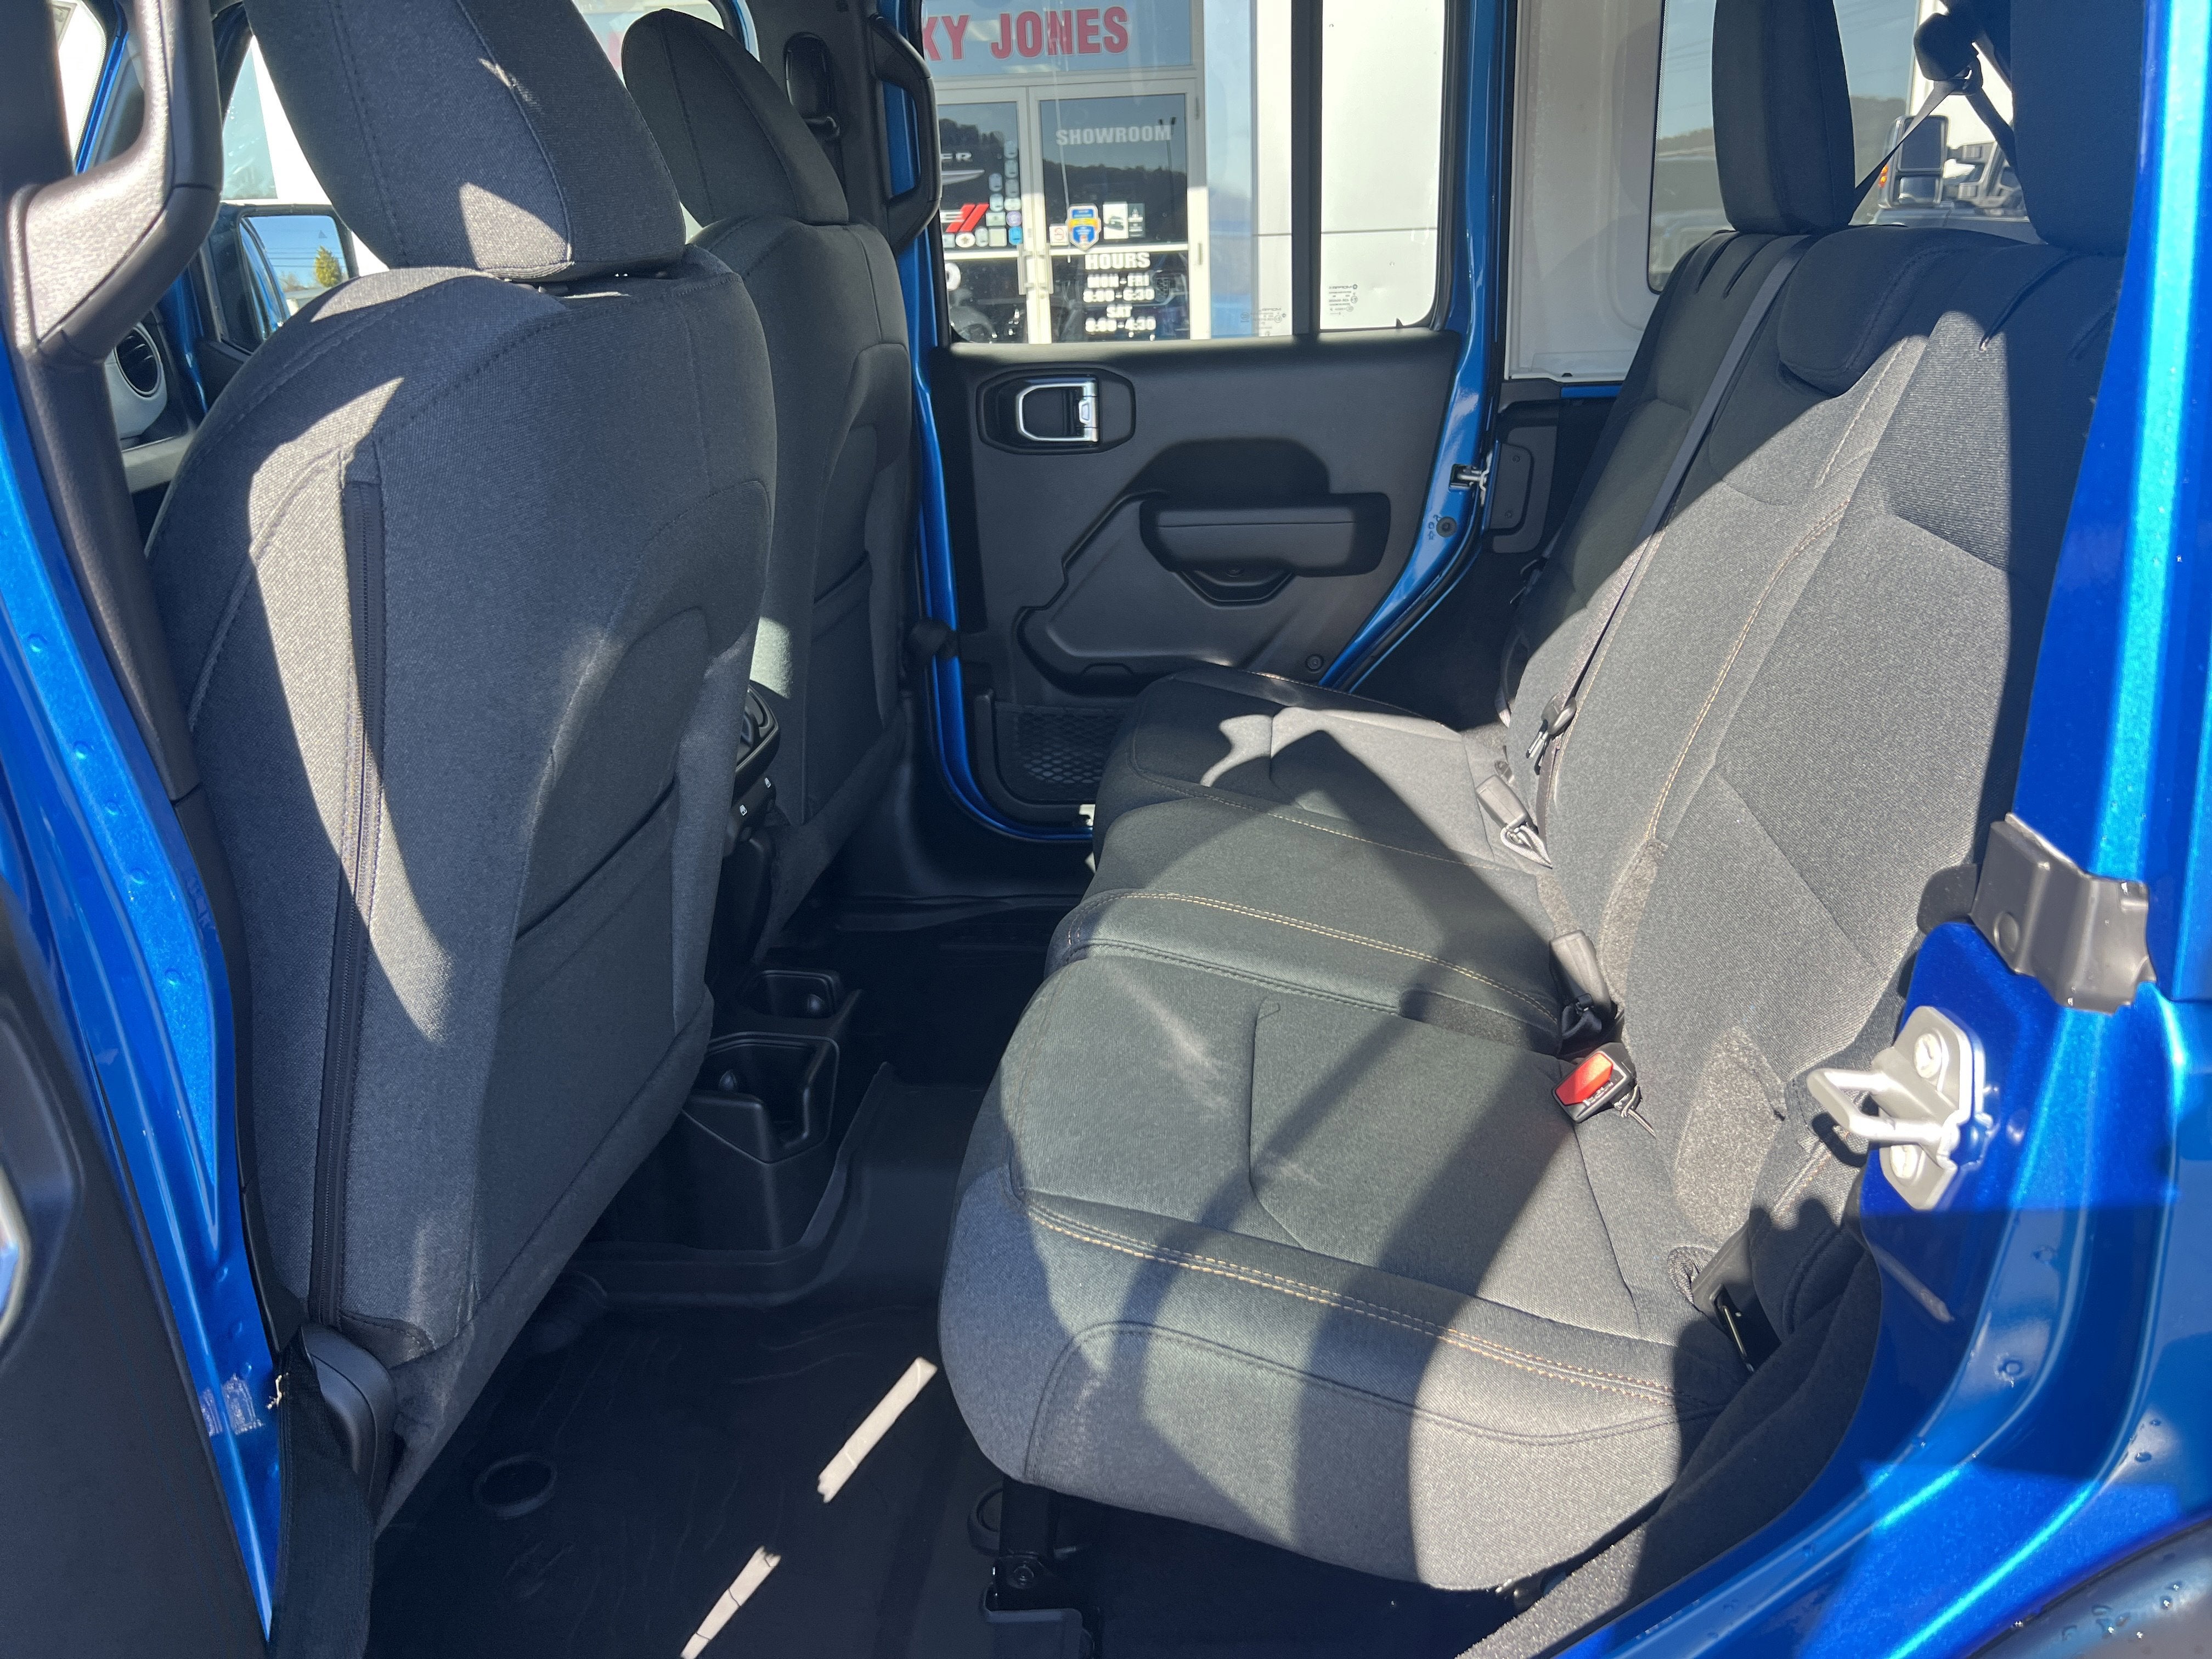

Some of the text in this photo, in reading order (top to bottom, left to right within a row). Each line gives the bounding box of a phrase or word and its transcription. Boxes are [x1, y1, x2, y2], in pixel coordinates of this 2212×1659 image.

[991, 6, 1130, 60] JONES
[1056, 125, 1172, 145] SHOWROOM
[1085, 252, 1151, 270] HOURS
[1106, 306, 1133, 318] SAT
